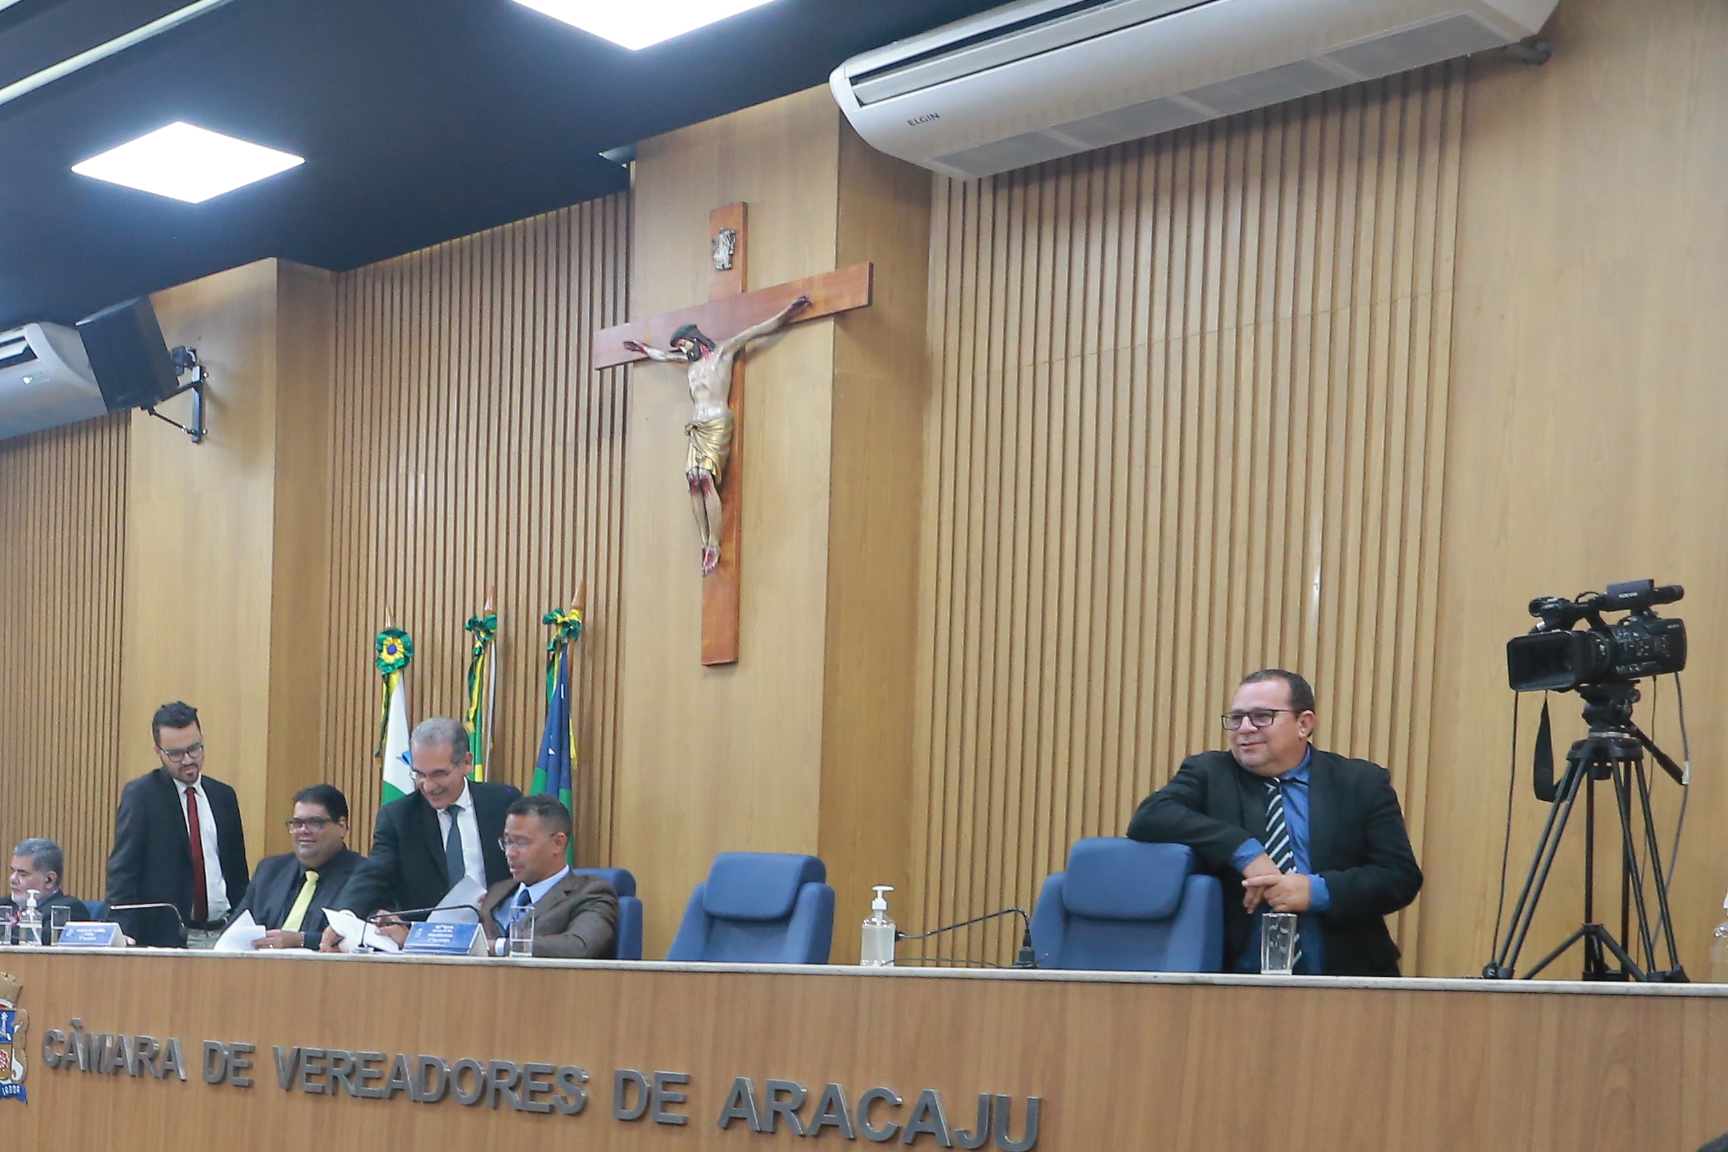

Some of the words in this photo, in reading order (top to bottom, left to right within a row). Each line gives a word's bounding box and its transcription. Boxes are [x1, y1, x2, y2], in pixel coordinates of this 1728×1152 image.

[907, 112, 941, 126] ELGIN
[41, 1018, 187, 1081] CÂMARA
[203, 1040, 255, 1088] DE
[273, 1045, 589, 1116] VEREADORES
[613, 1068, 691, 1126] DE
